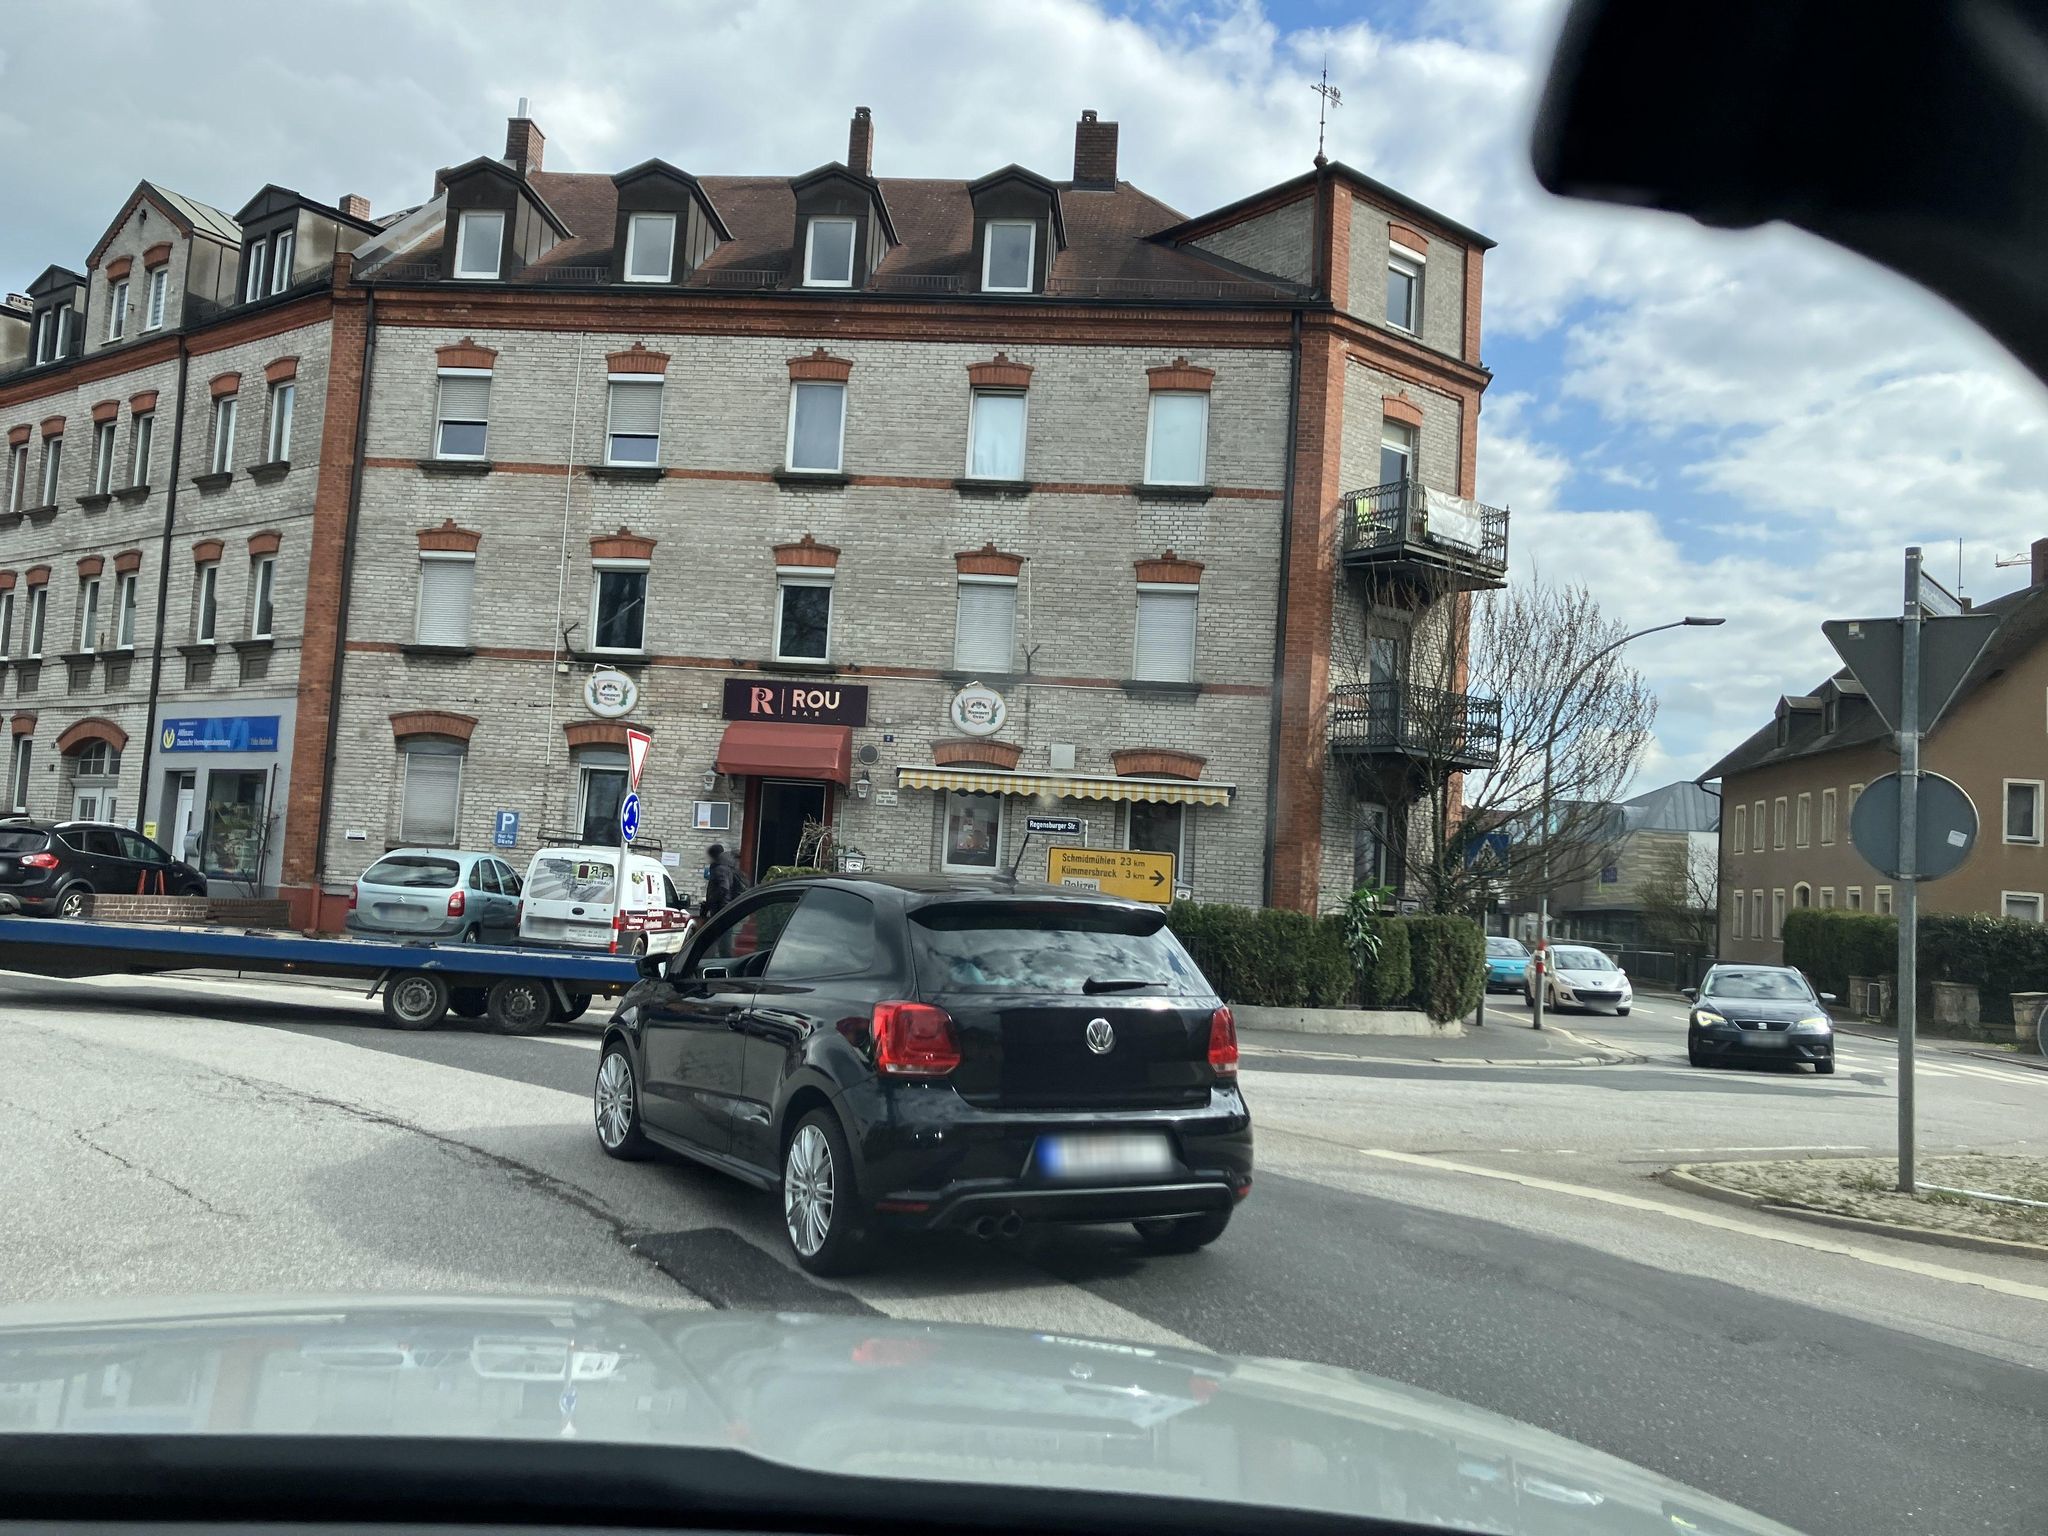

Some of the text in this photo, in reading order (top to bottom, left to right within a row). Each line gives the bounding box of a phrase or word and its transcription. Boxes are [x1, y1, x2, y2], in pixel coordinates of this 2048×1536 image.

[792, 689, 840, 710] ROU
[791, 709, 820, 717] BAR
[502, 813, 515, 831] P
[1029, 820, 1078, 831] Regensburger Str.
[1062, 852, 1146, 867] Schmidmühlen 23 km
[1061, 865, 1145, 880] Kümmersbruck 3 km
